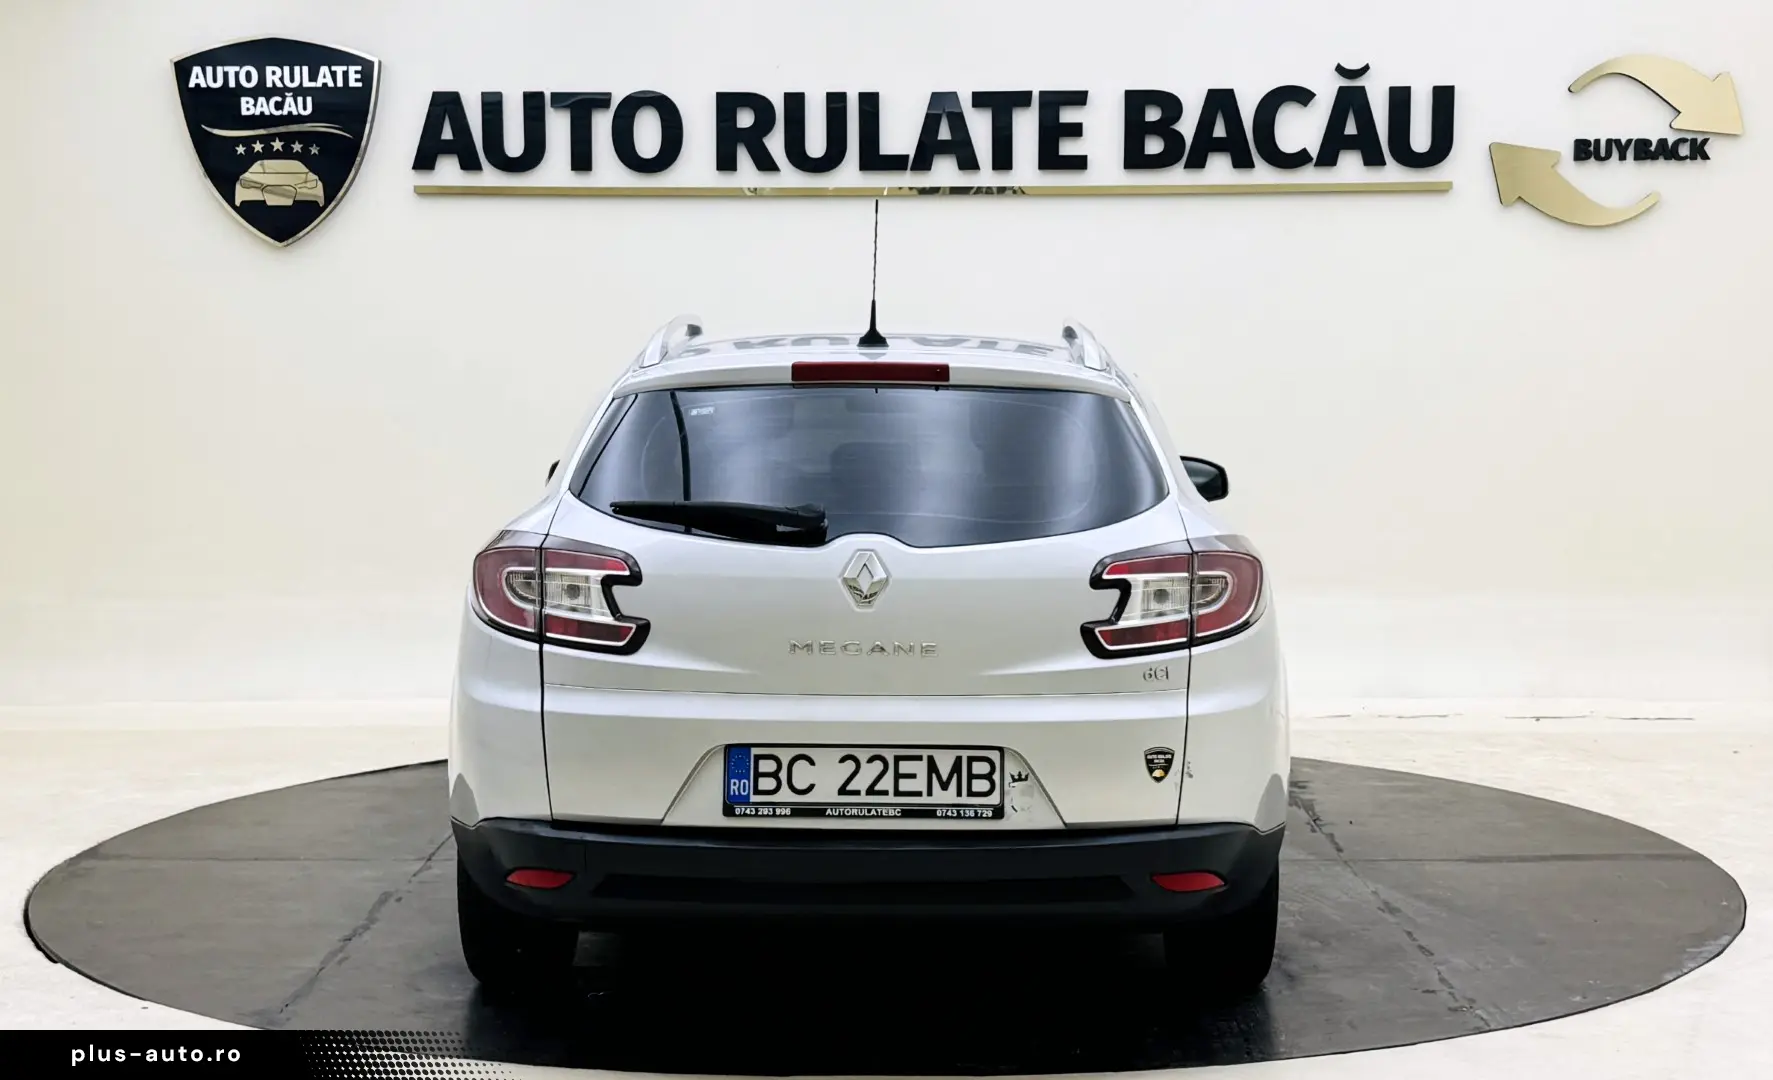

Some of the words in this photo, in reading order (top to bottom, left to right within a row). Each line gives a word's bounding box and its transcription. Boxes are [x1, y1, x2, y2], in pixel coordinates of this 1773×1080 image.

[188, 65, 259, 89] AUTO
[265, 65, 363, 88] RULATE
[240, 92, 313, 116] BACĂU
[412, 90, 684, 174] AUTO
[715, 90, 1089, 173] RULATE
[1123, 62, 1455, 171] BACĂU
[1573, 137, 1711, 162] BUYBACK
[788, 639, 939, 658] MEGANE
[752, 753, 816, 796] BC
[837, 753, 997, 798] 22EMB
[730, 778, 749, 796] RO
[734, 807, 756, 816] 0743
[825, 807, 902, 817] AUTORULATEBC
[936, 809, 957, 818] 0743
